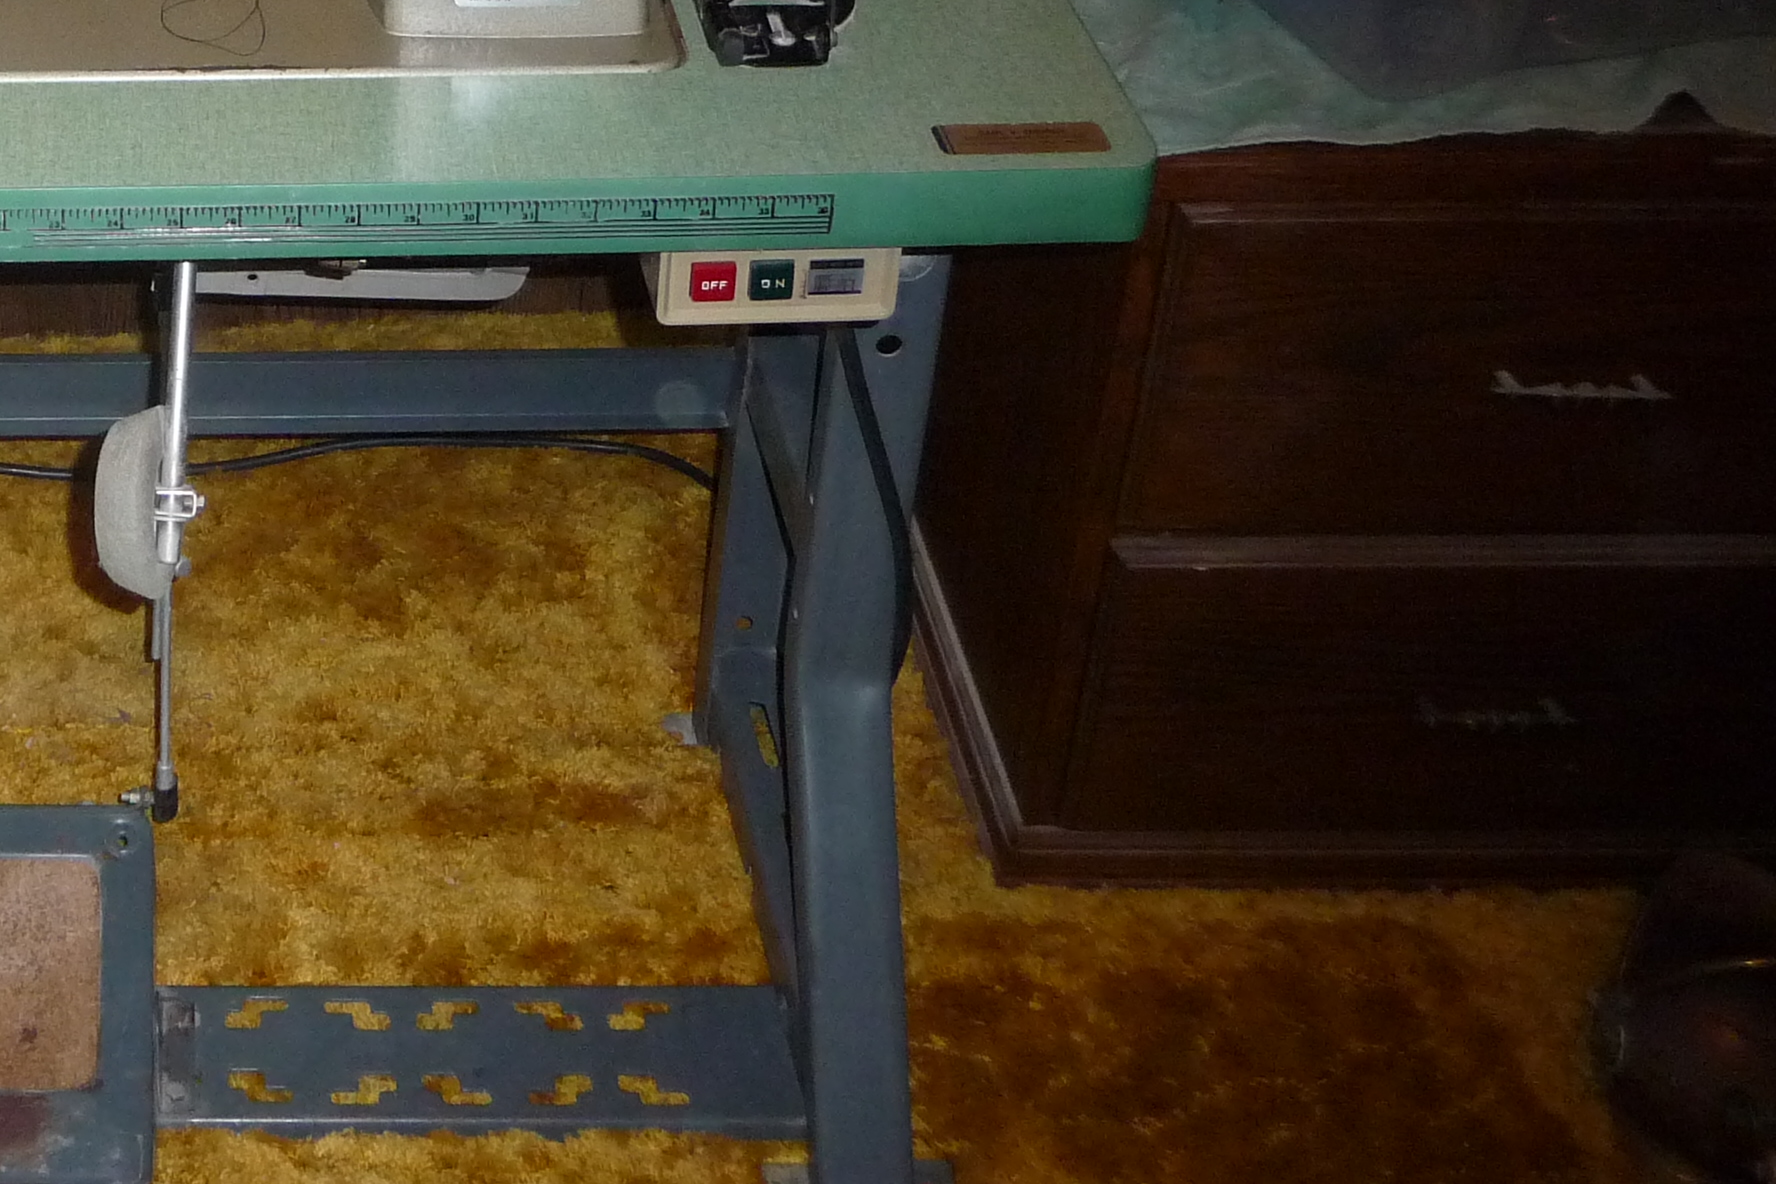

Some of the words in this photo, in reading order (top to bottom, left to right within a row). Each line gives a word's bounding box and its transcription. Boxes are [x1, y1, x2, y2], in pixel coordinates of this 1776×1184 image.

[462, 213, 475, 222] 30
[700, 280, 729, 291] OFF
[761, 278, 786, 289] ON
